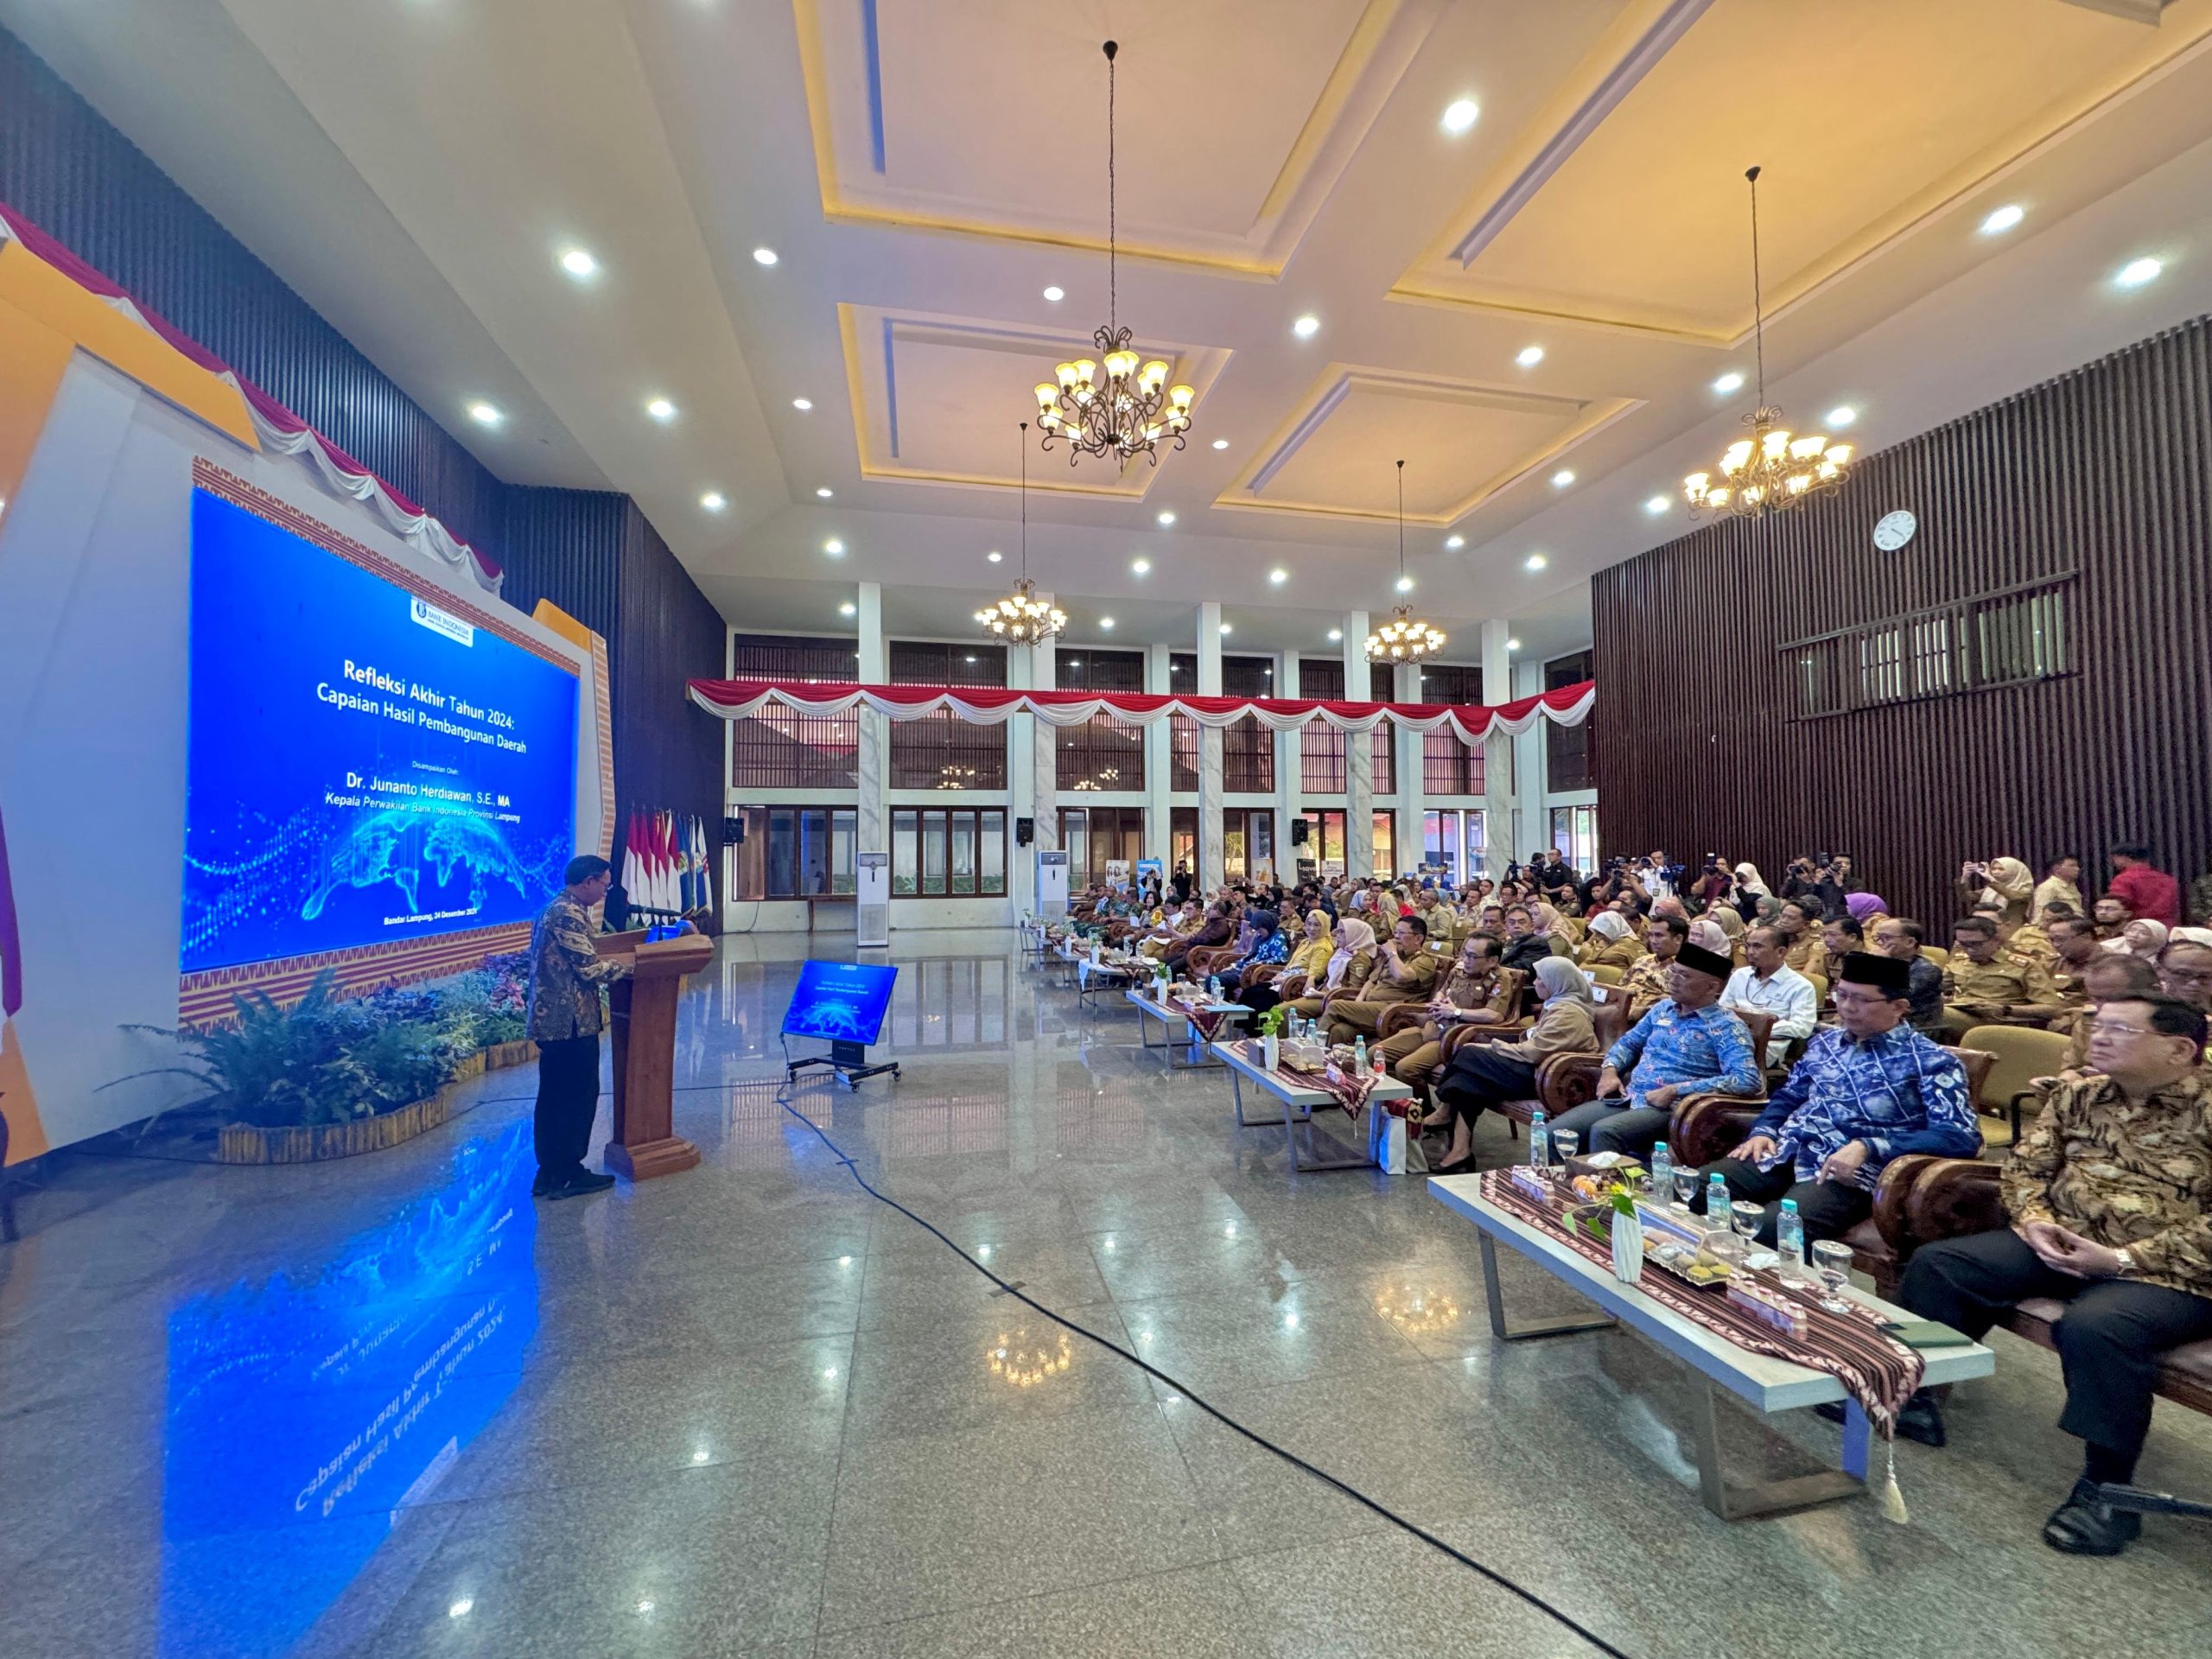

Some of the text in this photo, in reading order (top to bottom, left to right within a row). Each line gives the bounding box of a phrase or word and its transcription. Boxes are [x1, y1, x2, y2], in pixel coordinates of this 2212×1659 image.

[344, 659, 515, 730] Refleksi Akhir Tahun 2024:
[317, 683, 527, 753] Capaian Hasil Pembangunan Daerah
[346, 772, 365, 789] Dr.
[370, 776, 417, 796] Junanto
[497, 794, 511, 807] MA
[325, 792, 360, 807] Kepala
[363, 796, 409, 811] Perwakilan
[412, 802, 431, 813] Bank
[469, 808, 494, 819] Provinsi
[494, 811, 520, 823] Lampung
[384, 916, 406, 925] Bandar
[406, 913, 433, 923] Lampung,
